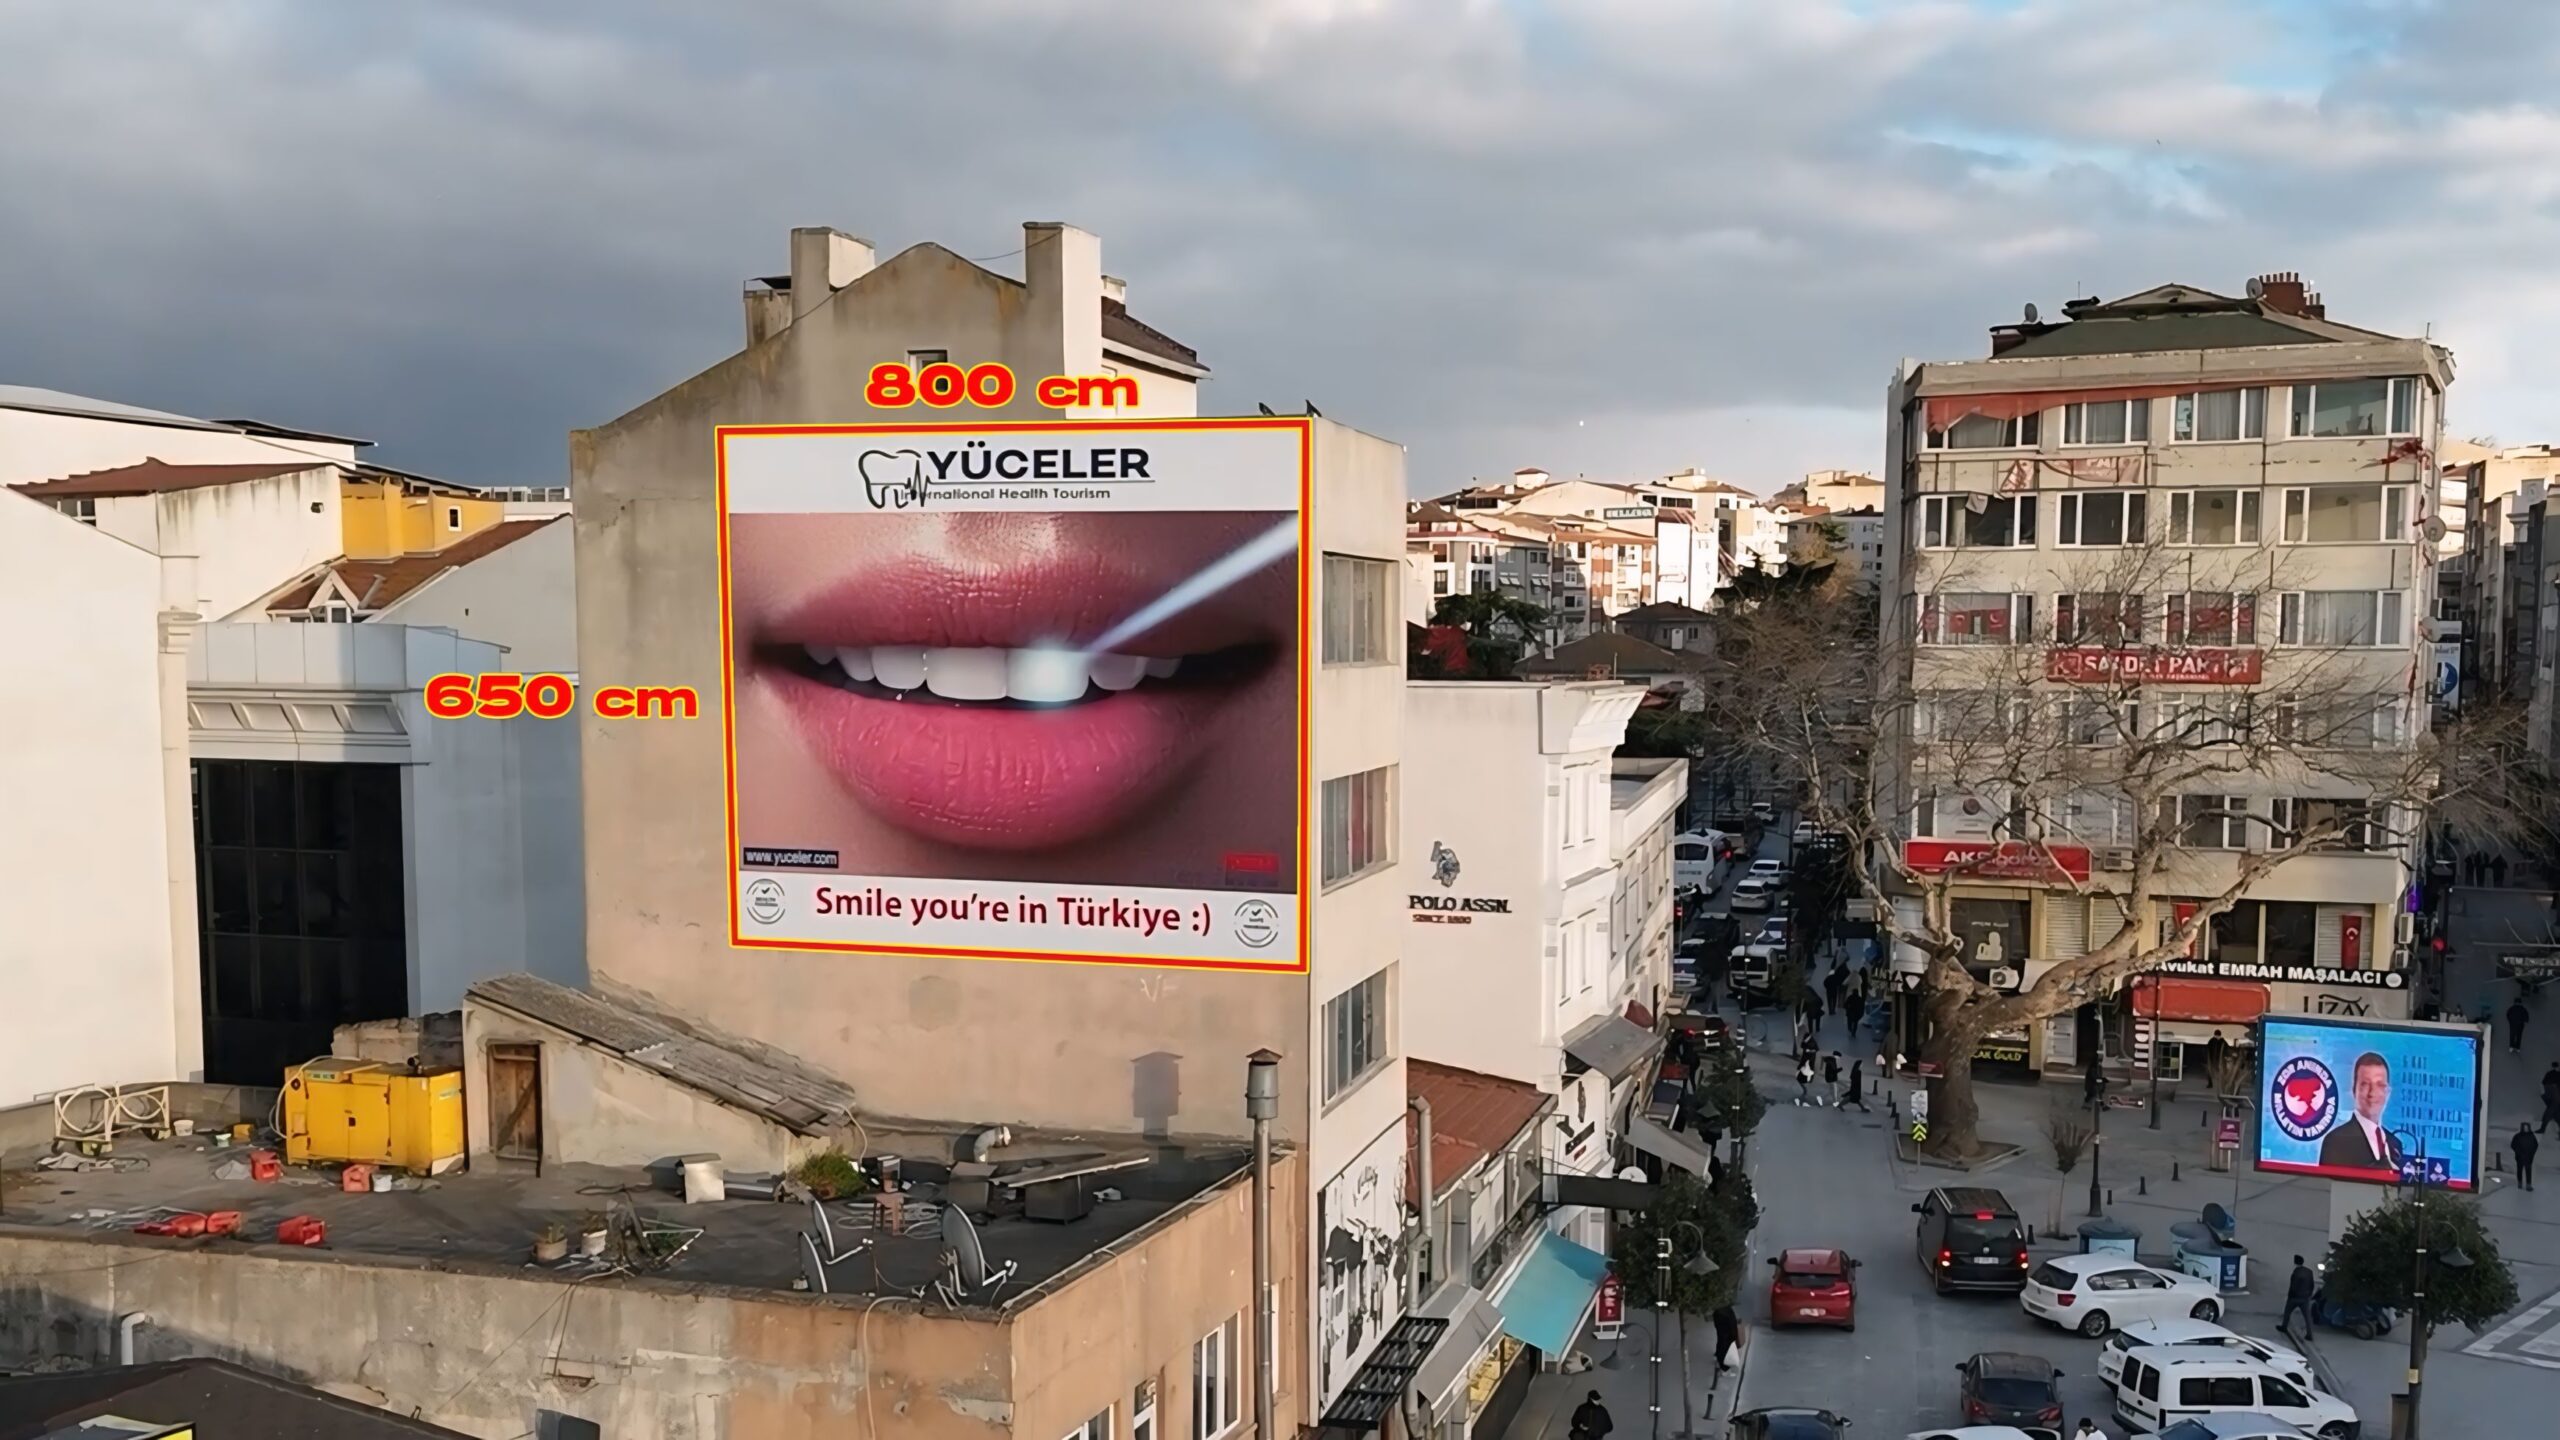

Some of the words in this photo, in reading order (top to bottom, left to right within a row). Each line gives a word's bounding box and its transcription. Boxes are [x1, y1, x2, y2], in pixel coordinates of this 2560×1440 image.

[926, 440, 1151, 480] YÜCELER
[900, 488, 995, 500] Inrnational
[999, 487, 1048, 500] Health
[1053, 487, 1111, 500] Tourism
[745, 850, 837, 866] www.yuceler.com
[816, 887, 902, 917] Smile
[911, 893, 1010, 925] you're
[1019, 895, 1048, 924] in
[1057, 897, 1181, 937] Türkiye
[1191, 902, 1211, 937] :)
[1408, 895, 1457, 911] POLO
[2156, 960, 2215, 975] Avukat
[2219, 963, 2283, 979] EMRAH
[2287, 966, 2381, 984] MAŞALACI
